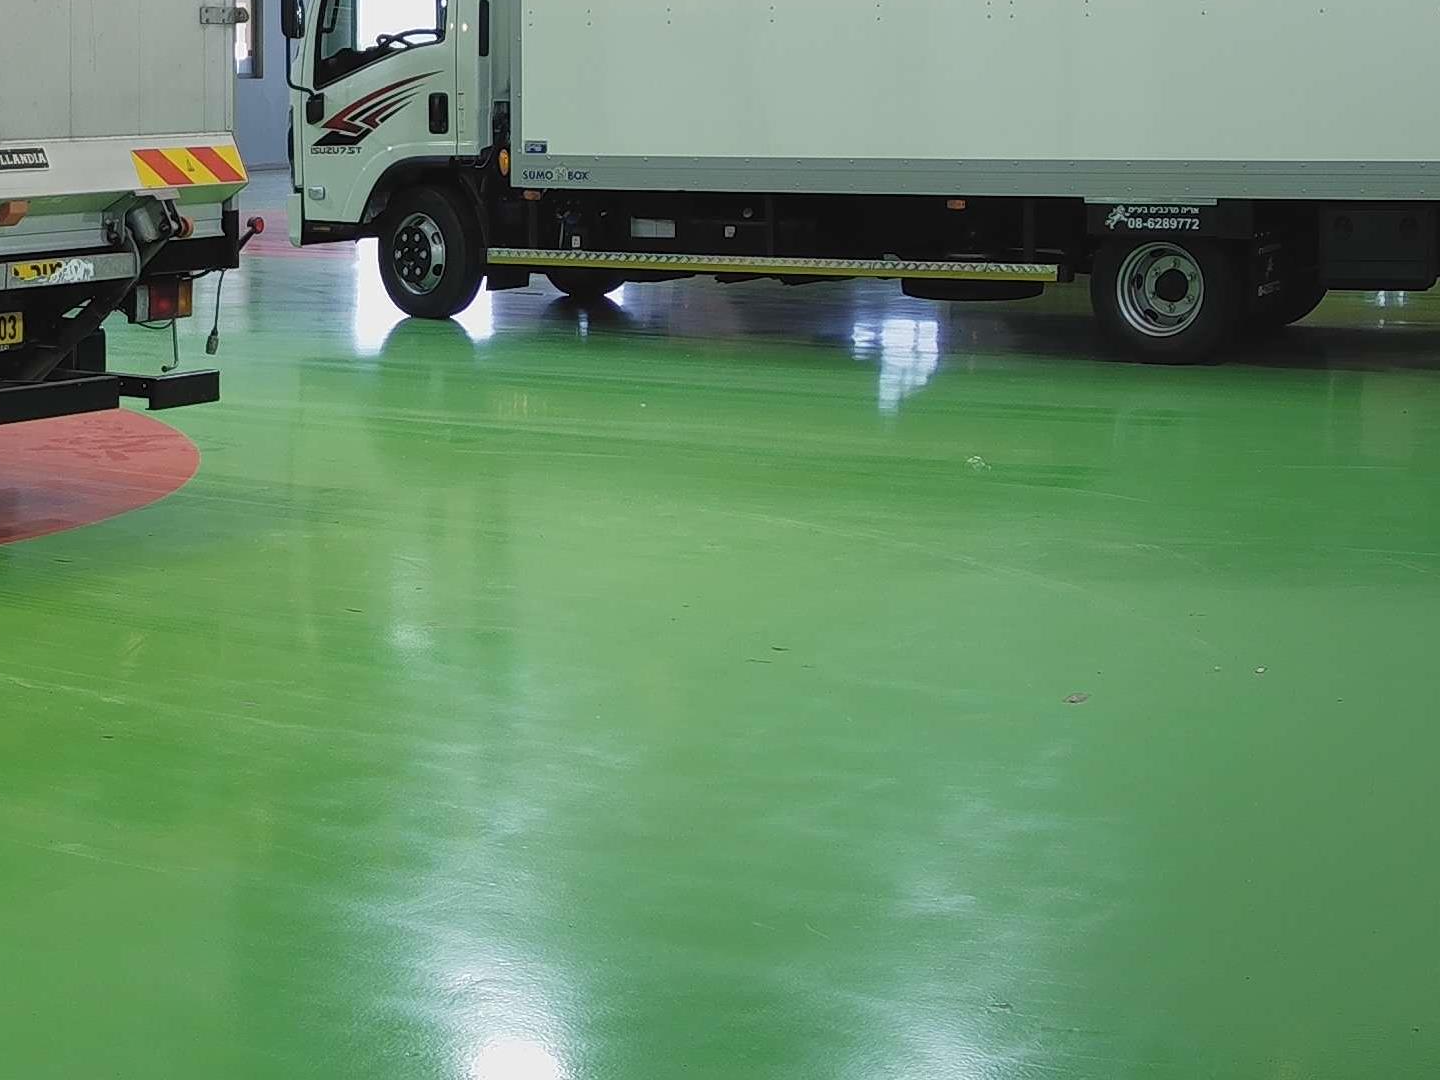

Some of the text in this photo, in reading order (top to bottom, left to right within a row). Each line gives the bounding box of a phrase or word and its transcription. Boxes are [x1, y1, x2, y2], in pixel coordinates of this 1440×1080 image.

[522, 168, 590, 181] SUMO BOX
[1127, 217, 1200, 230] 08-6289772
